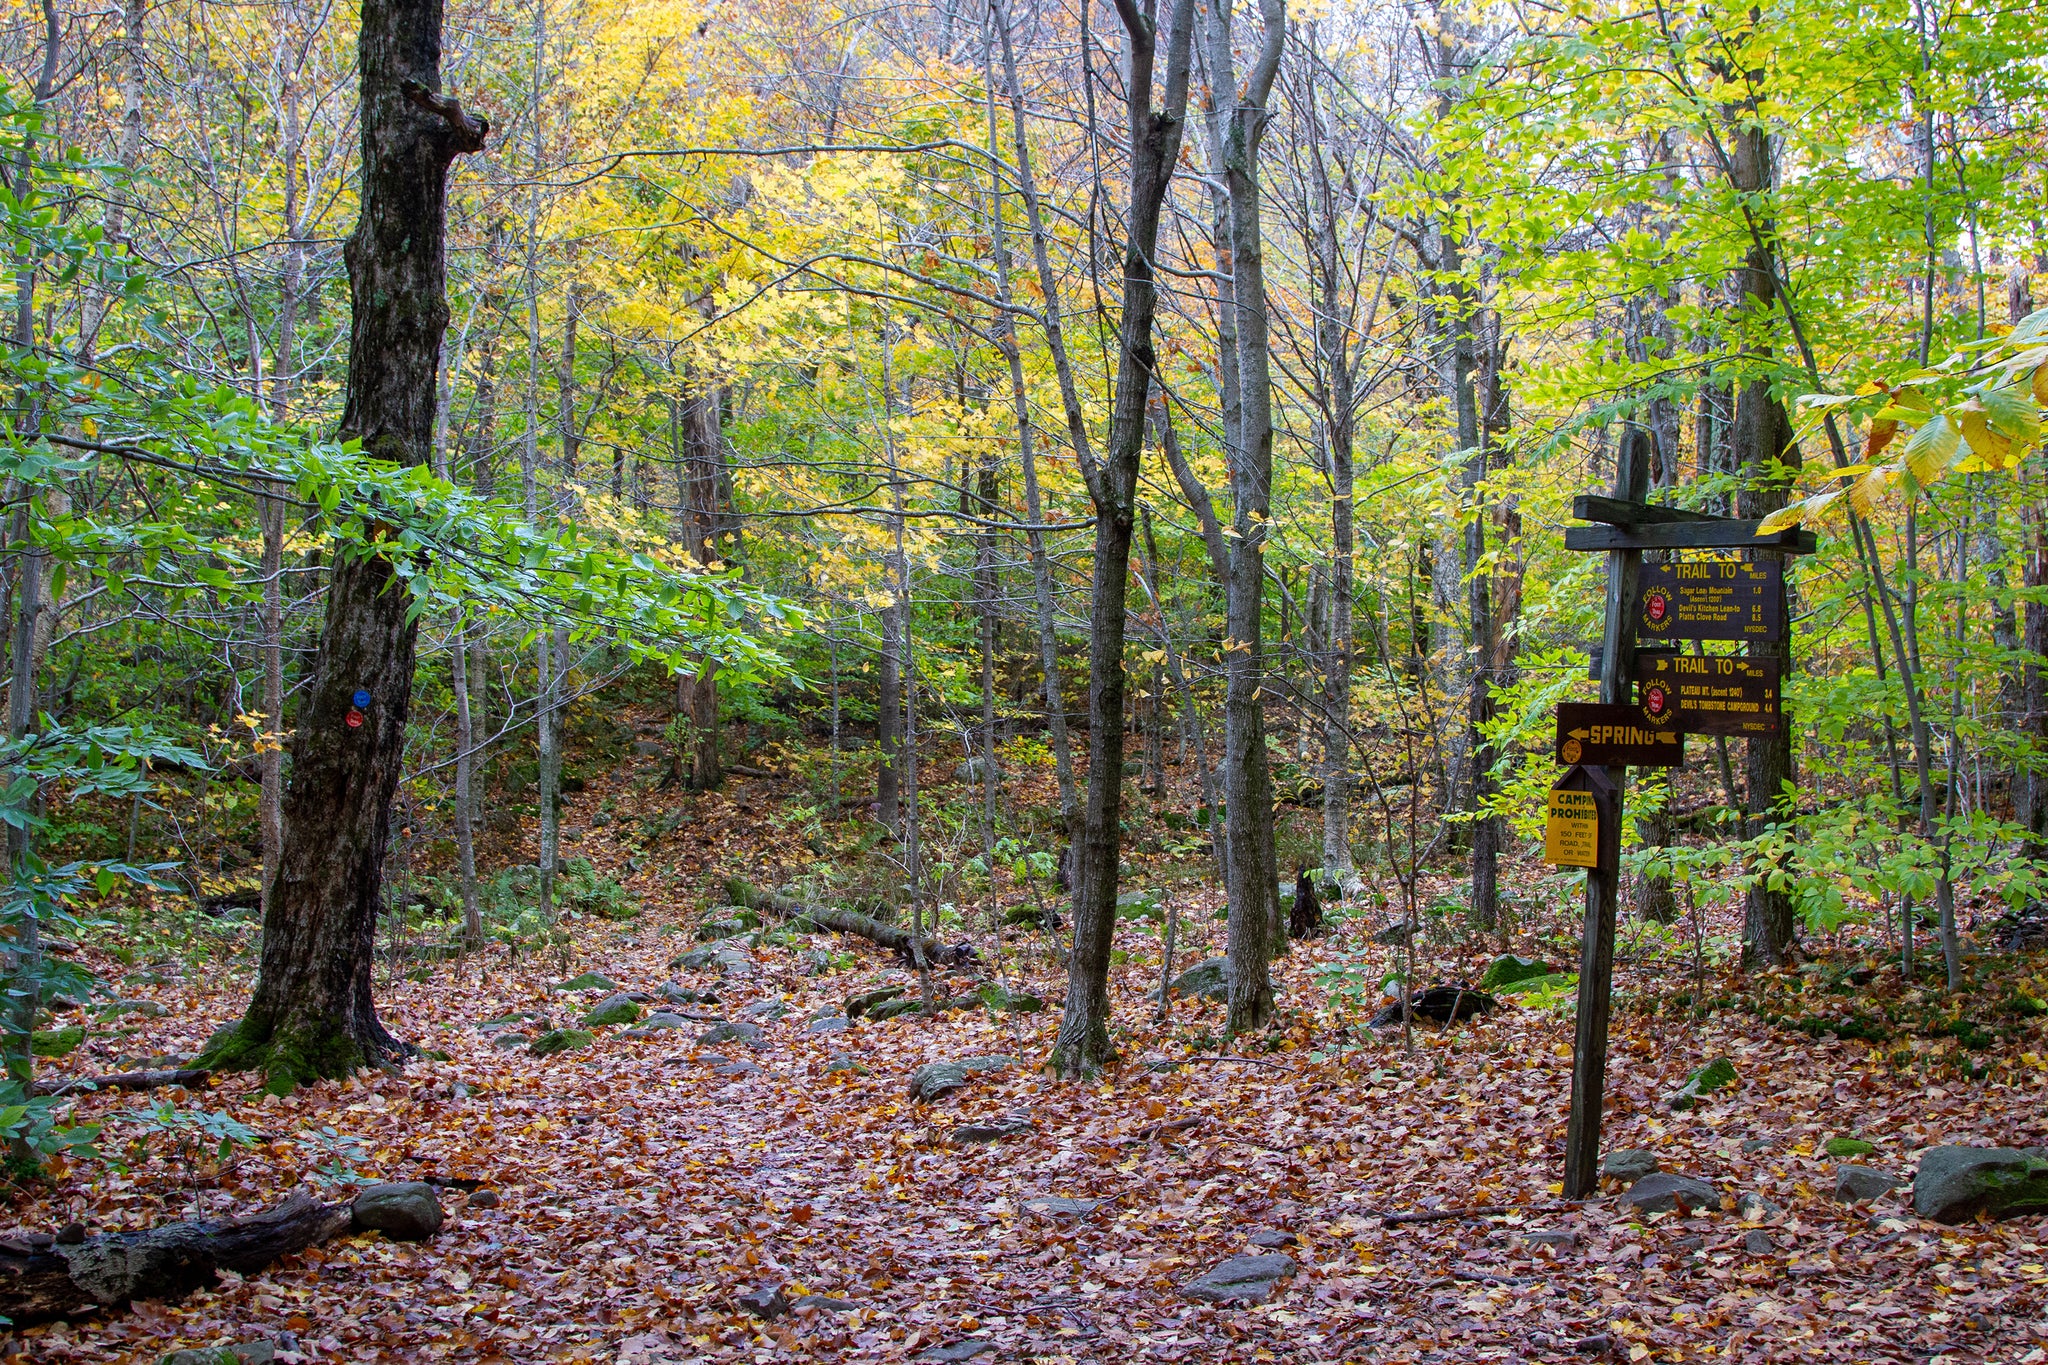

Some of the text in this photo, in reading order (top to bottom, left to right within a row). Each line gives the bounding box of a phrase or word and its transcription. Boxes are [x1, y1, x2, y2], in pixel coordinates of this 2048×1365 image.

[1675, 563, 1737, 579] TRAIL TO
[1749, 571, 1767, 579] MILES
[1643, 585, 1673, 602] FOLLOW
[1680, 586, 1762, 596] Sugar Loa Mountain 1.0
[1679, 604, 1697, 612] Devil's
[1698, 604, 1719, 613] Kitchen
[1720, 604, 1741, 613] Lean-to
[1643, 614, 1673, 632] MARKERS
[1696, 613, 1712, 621] Clove
[1713, 613, 1728, 621] Road
[1744, 625, 1768, 633] NYSDEC
[1673, 657, 1733, 675] TRAIL TO
[1746, 669, 1763, 677] MILES
[1642, 678, 1672, 696] FOLLOW
[1680, 685, 1701, 696] PLATEAU
[1764, 688, 1773, 699] 3.4
[1699, 700, 1726, 711] TOMBSTONE
[1727, 701, 1760, 713] CAMPGROUND
[1764, 703, 1773, 713] 4.4
[1642, 706, 1673, 725] MARKERS
[1742, 722, 1766, 731] NYSDEC
[1590, 725, 1655, 745] SPRING
